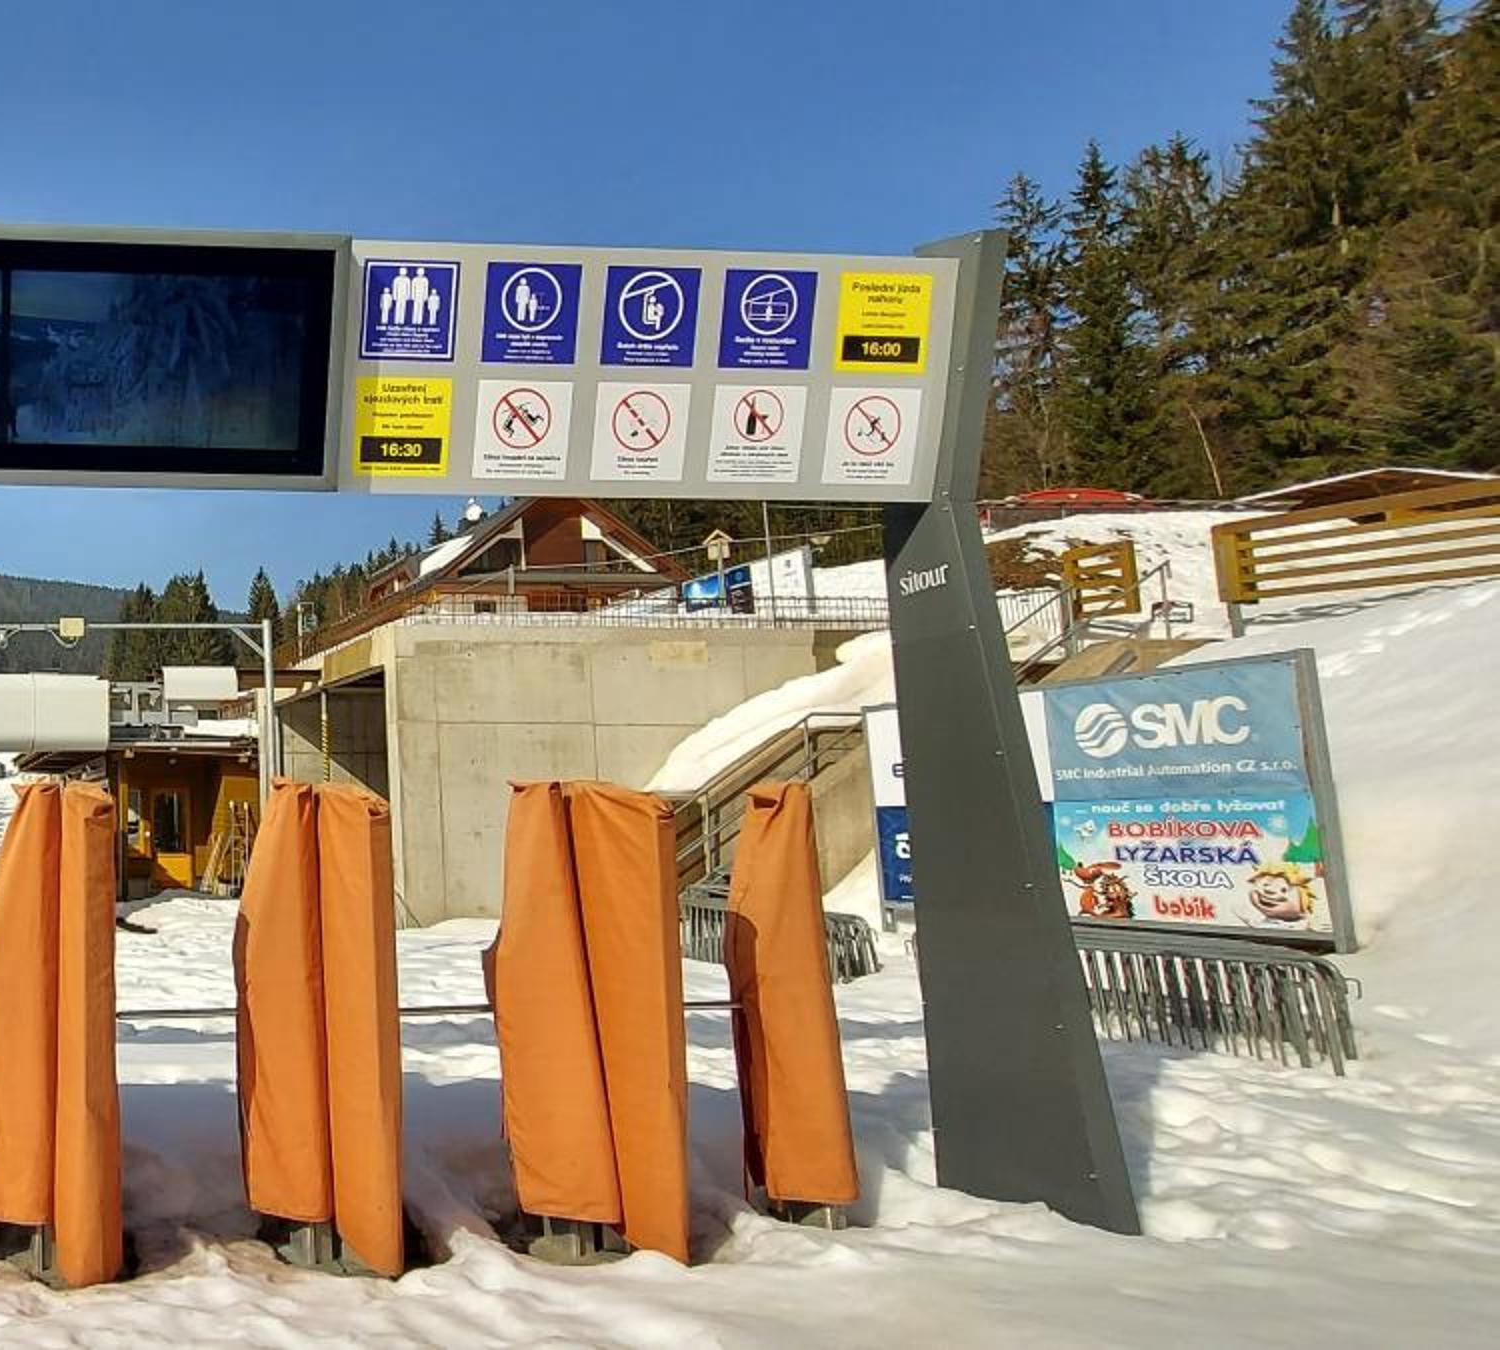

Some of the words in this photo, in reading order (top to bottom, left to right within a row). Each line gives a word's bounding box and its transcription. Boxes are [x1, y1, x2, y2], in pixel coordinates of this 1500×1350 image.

[861, 341, 901, 357] 16:00
[380, 441, 422, 457] 16:30
[899, 563, 949, 596] sitour
[1130, 696, 1250, 749] SMC
[1056, 768, 1082, 780] SMC
[1083, 764, 1144, 779] Industrial
[1146, 761, 1232, 777] Automation
[1235, 759, 1256, 773] CZ
[1260, 758, 1298, 772] s.r.o.
[1091, 801, 1131, 814] nauč
[1135, 803, 1154, 814] se
[1159, 800, 1212, 813] dobře
[1216, 799, 1285, 814] lyžovat
[1107, 816, 1264, 838] BOBÍKOVA
[1115, 841, 1260, 865] LYŽAŘSKÁ
[1143, 866, 1234, 889] ŠKOLA
